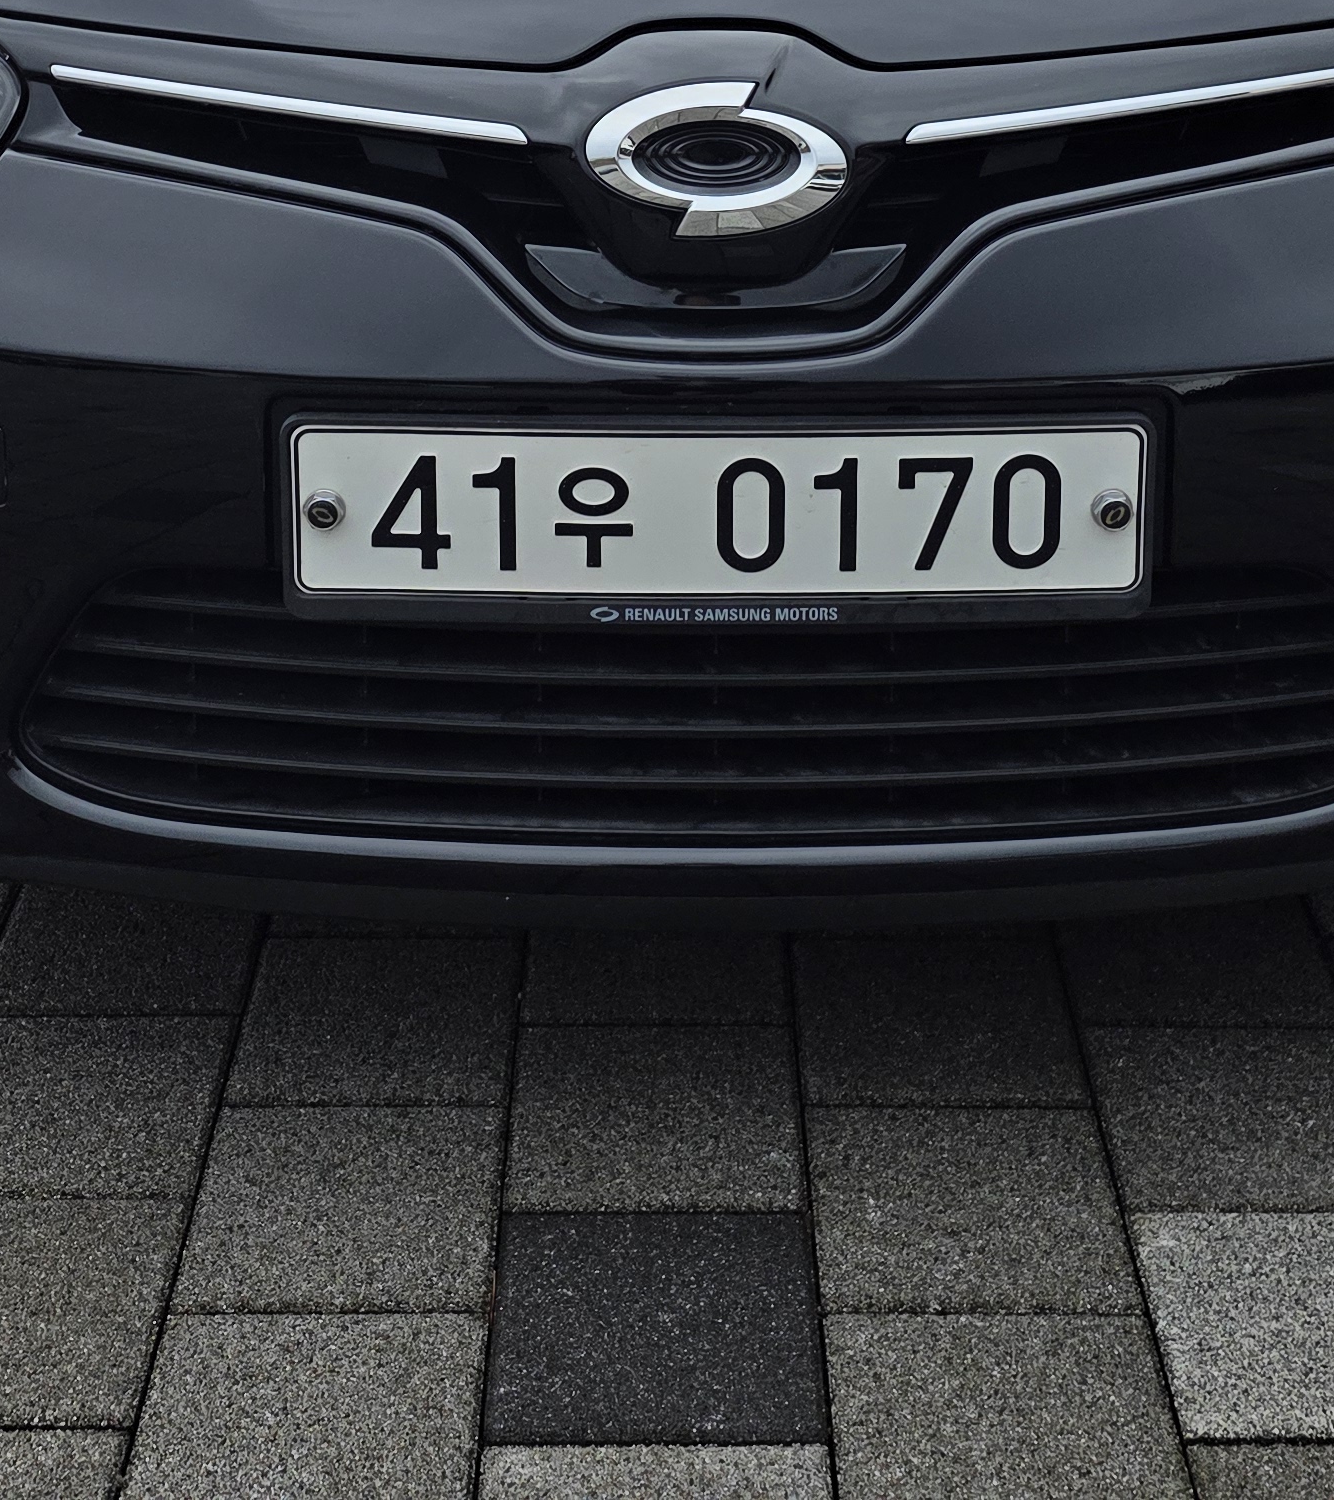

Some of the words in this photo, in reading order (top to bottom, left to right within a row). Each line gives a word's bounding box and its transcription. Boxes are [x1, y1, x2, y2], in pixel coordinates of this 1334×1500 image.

[370, 454, 634, 572] 41우
[715, 454, 1063, 573] 0170
[624, 607, 691, 622] RENAULT
[694, 607, 772, 622] SAMSUNG
[775, 606, 839, 622] MOTORS
